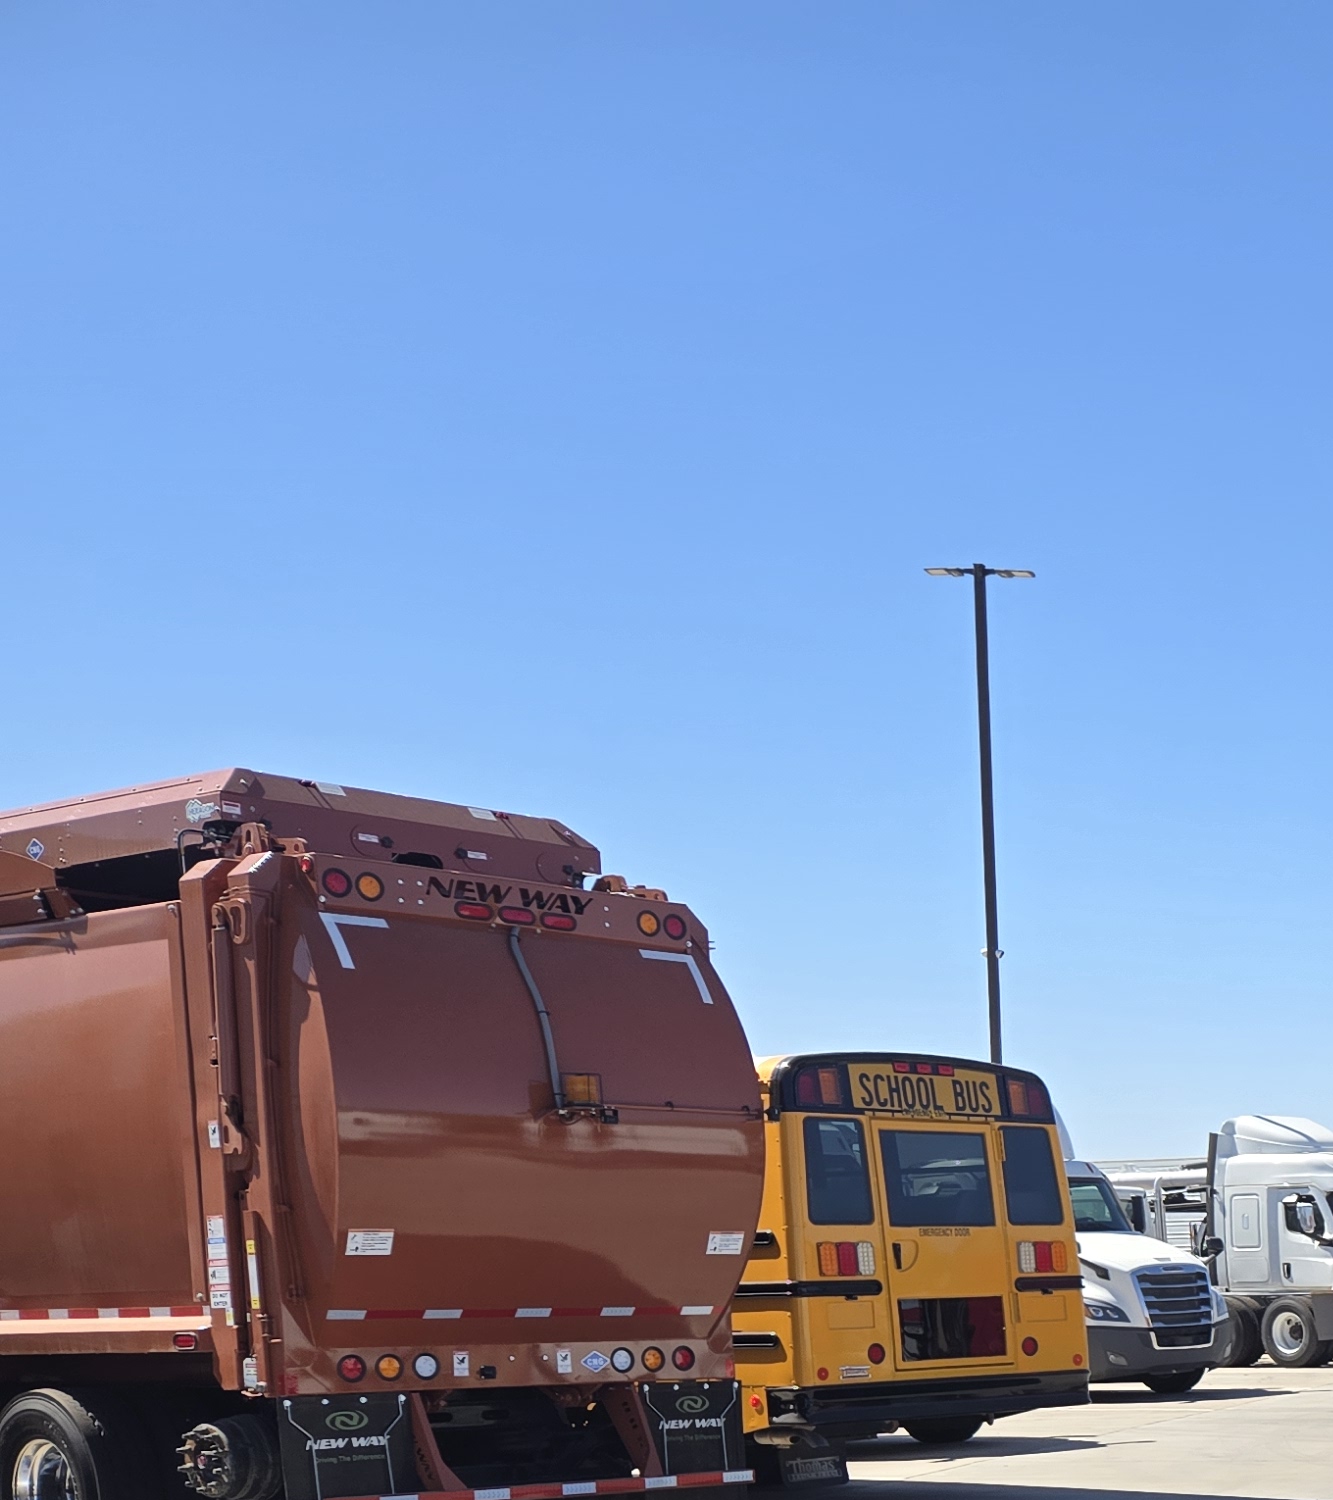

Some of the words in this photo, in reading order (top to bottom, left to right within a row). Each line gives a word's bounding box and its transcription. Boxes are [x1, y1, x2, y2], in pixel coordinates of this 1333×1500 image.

[425, 876, 513, 904] NEW
[519, 887, 594, 916] WAY
[858, 1072, 944, 1111] SCHOOL
[951, 1079, 993, 1114] BUS
[919, 1227, 953, 1237] EMERGENCY
[954, 1227, 971, 1237] DOOR
[586, 1357, 604, 1367] CNG
[659, 1418, 692, 1430] NEW
[695, 1416, 726, 1428] WAY
[305, 1436, 350, 1451] NEW
[350, 1434, 391, 1448] WAY
[785, 1455, 840, 1474] Thomas
